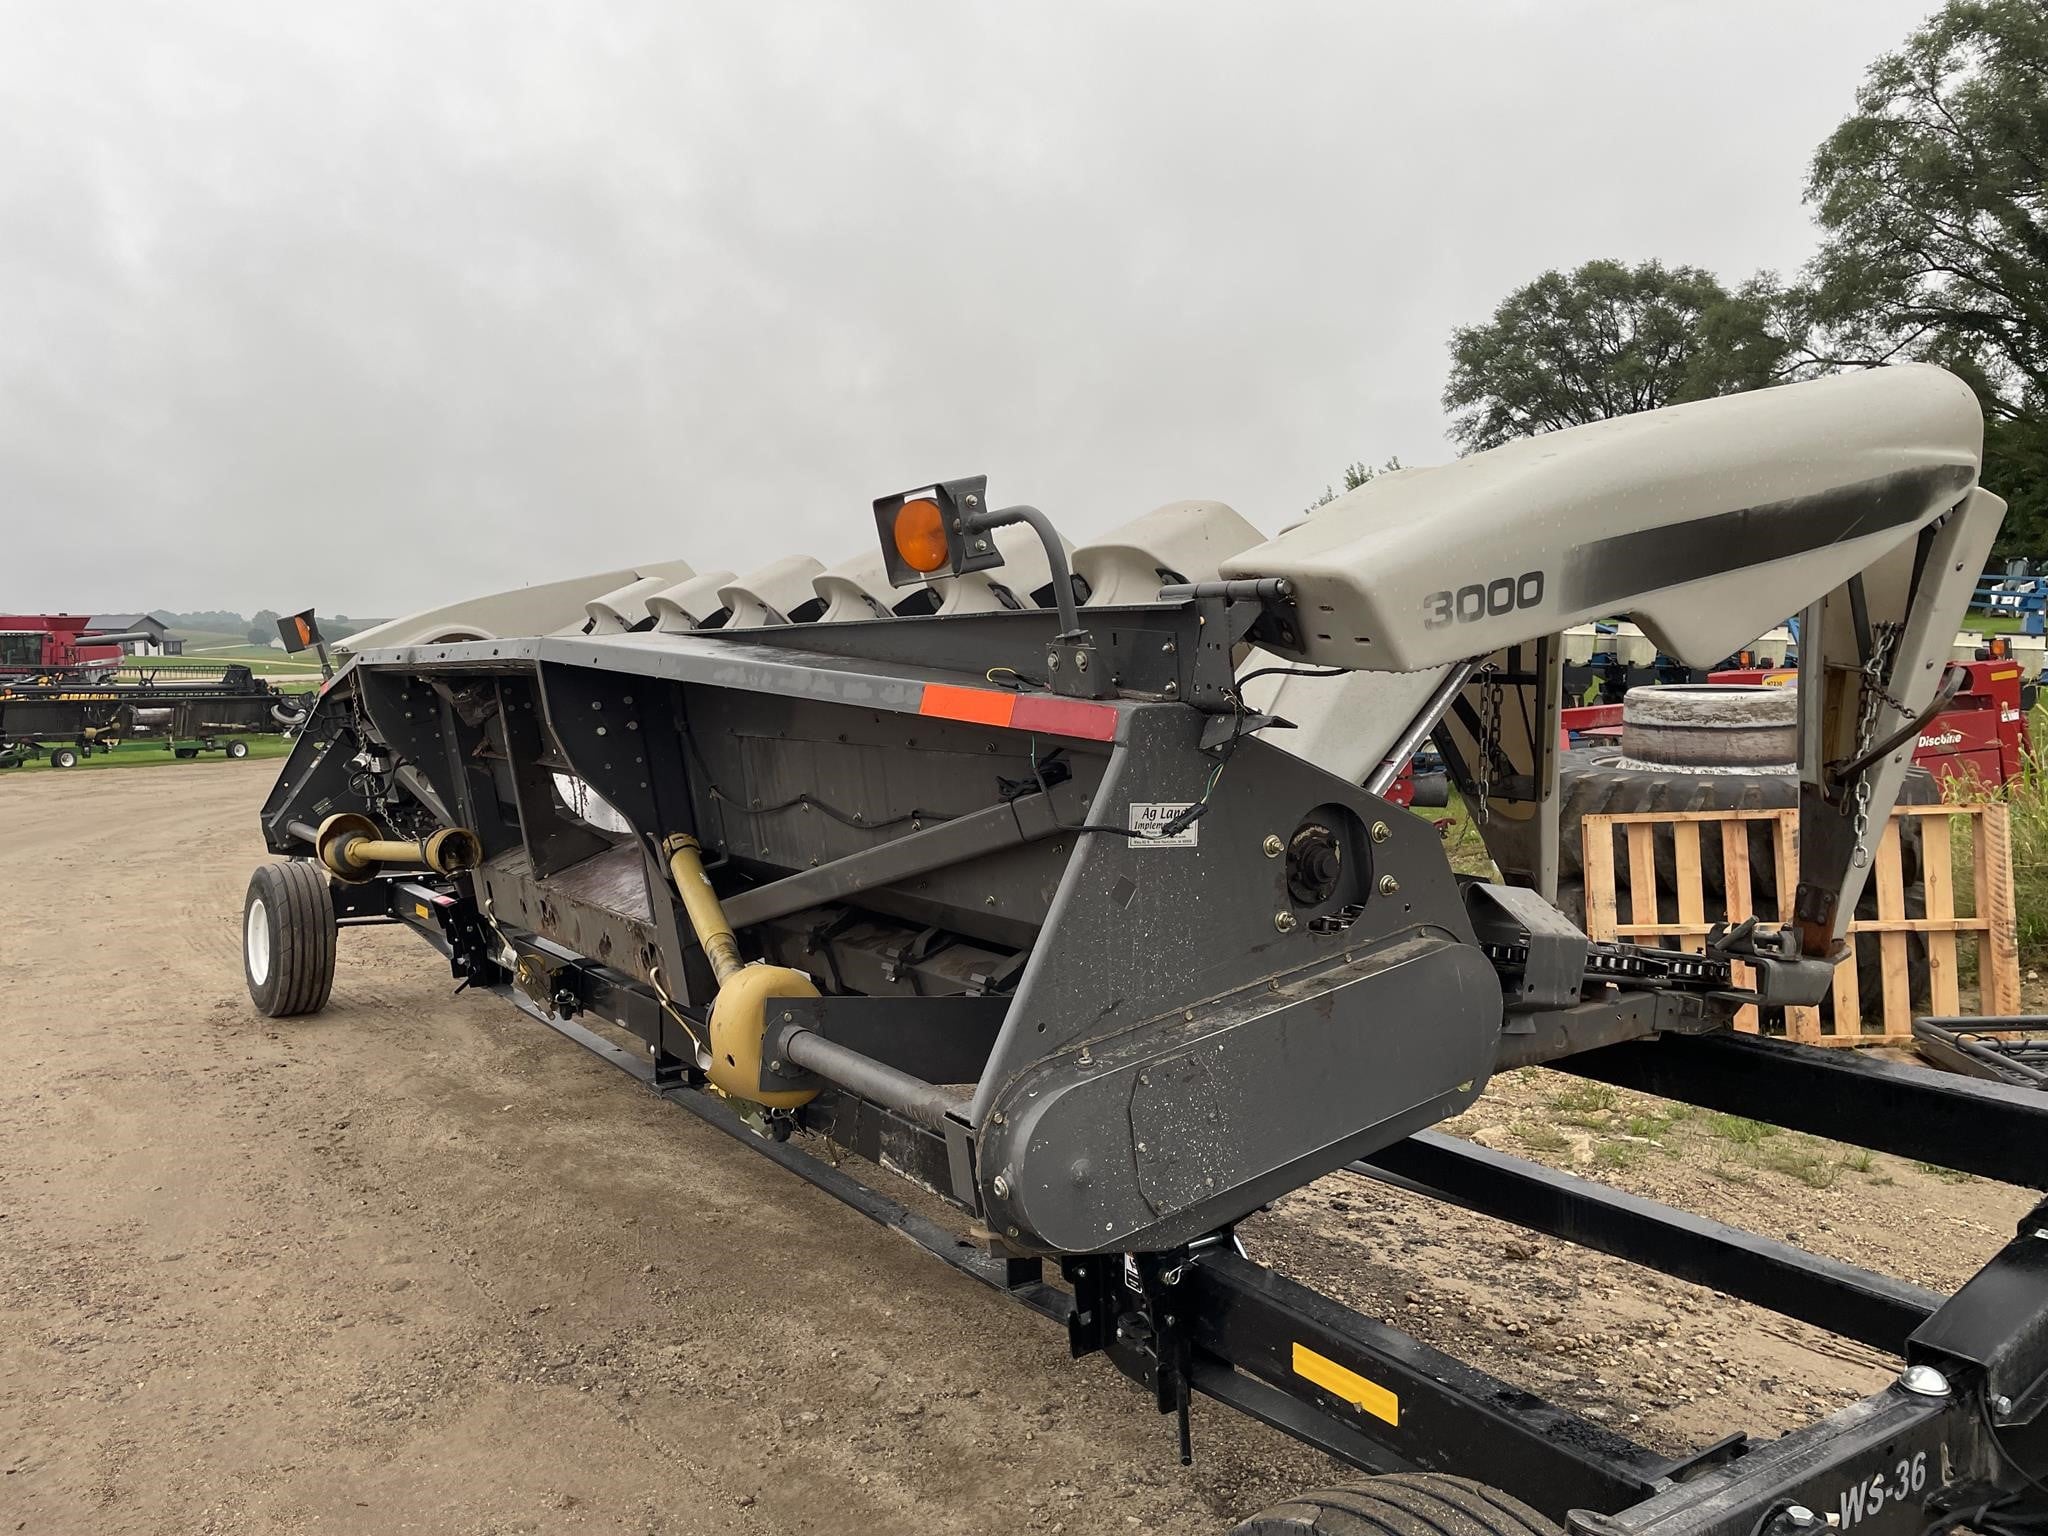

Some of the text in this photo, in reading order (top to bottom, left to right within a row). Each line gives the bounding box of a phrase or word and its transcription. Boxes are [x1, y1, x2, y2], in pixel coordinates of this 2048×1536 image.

[1423, 570, 1545, 631] 3000
[1918, 733, 1962, 748] Discbine
[1142, 807, 1157, 821] Ag
[1840, 1451, 1927, 1530] WS-36
